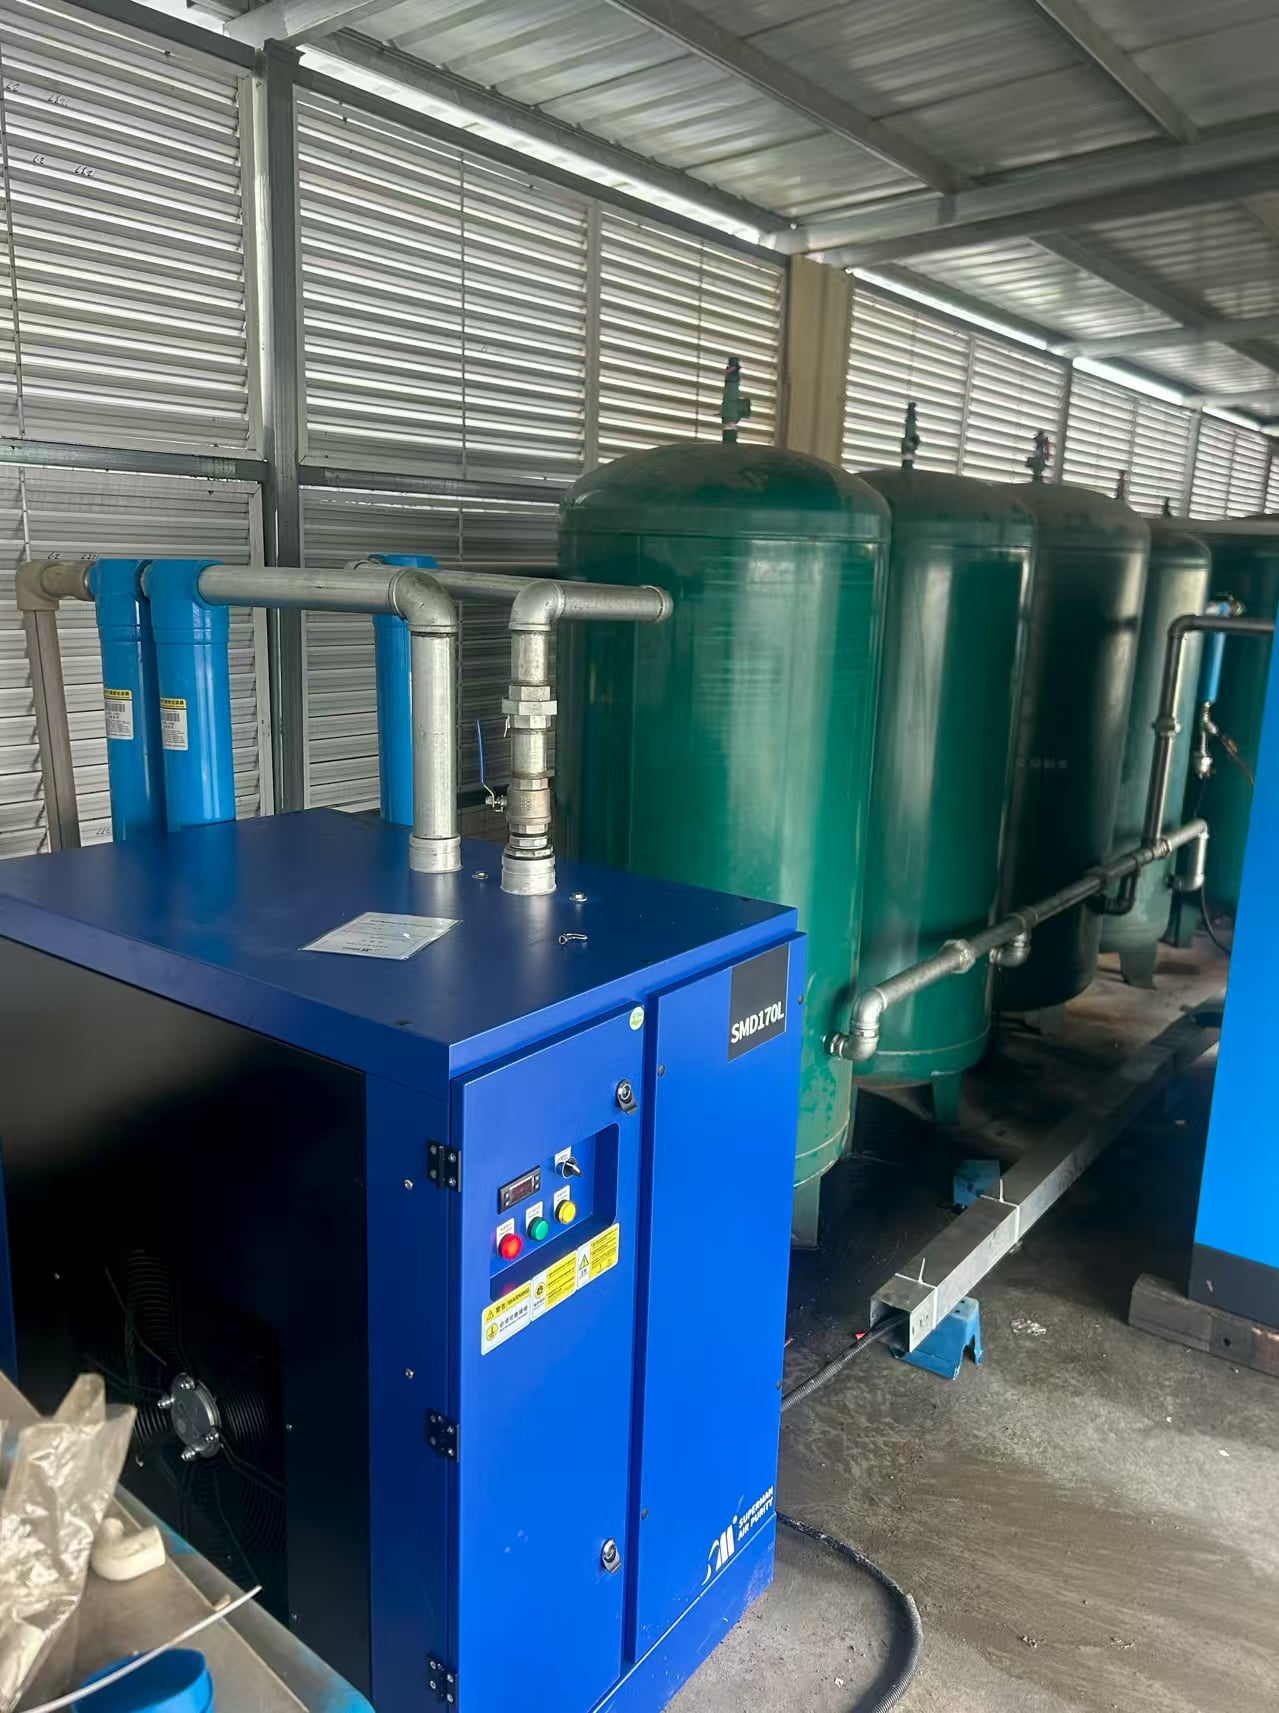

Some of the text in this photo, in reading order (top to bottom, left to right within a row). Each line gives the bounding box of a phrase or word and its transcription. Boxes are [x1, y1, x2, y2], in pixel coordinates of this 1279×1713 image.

[730, 1001, 785, 1043] SMD170L
[737, 1496, 774, 1541] AIR PURITY
[738, 1485, 774, 1528] SUPERMAN
